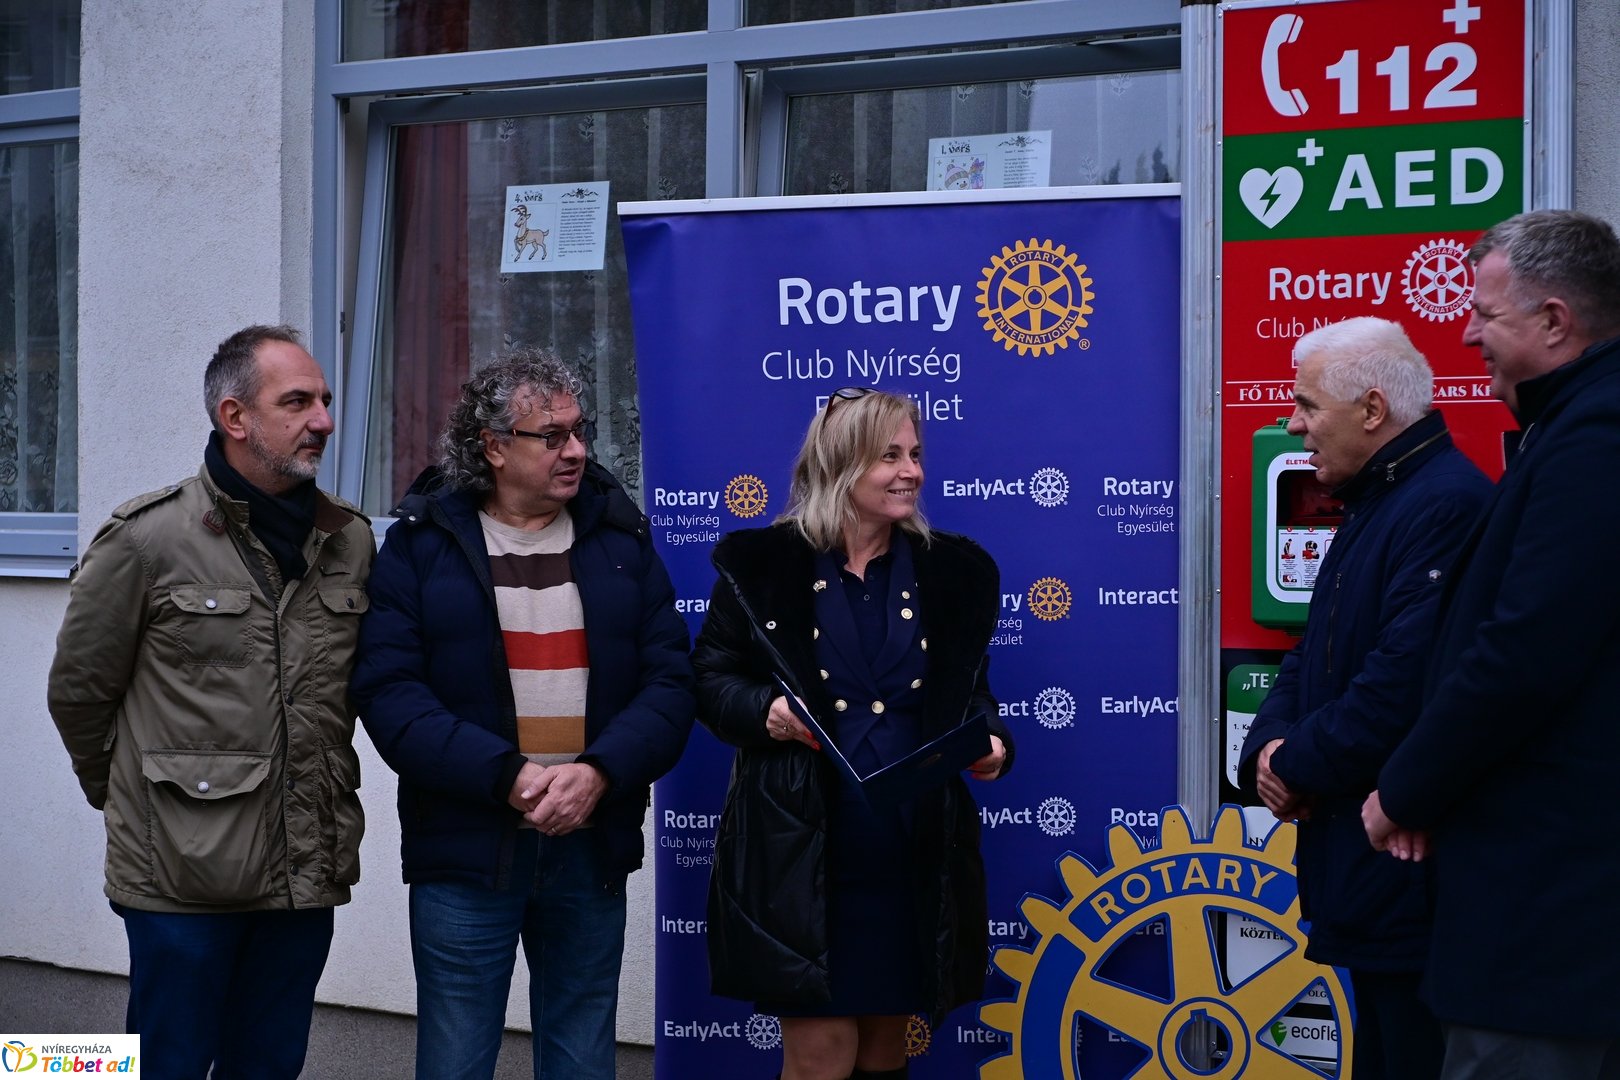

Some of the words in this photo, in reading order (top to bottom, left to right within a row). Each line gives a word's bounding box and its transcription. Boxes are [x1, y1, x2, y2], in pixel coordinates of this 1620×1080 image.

[1326, 42, 1477, 114] 112
[1328, 147, 1504, 211] AED
[1009, 251, 1059, 266] ROTARY
[1424, 247, 1459, 259] ROTARY
[1269, 267, 1392, 305] Rotary
[779, 277, 961, 332] Rotary
[1413, 292, 1472, 314] INTERNATIONAL
[995, 314, 1078, 344] INTERNATIONAL
[1256, 316, 1305, 338] Club
[762, 349, 834, 380] Club
[847, 347, 961, 385] Nyírség
[1239, 384, 1262, 400] FŐ
[943, 478, 1025, 500] EarlyAct
[1103, 477, 1174, 498] Rotary
[655, 488, 719, 509] Rotary
[1097, 504, 1126, 516] Club
[1129, 503, 1174, 518] Nyírség
[651, 514, 673, 526] Club
[677, 514, 720, 528] Nyírség
[1117, 520, 1174, 535] Egyesület
[666, 531, 720, 545] Egyesület
[1099, 587, 1179, 605] Interact
[997, 616, 1022, 631] rség
[988, 633, 1023, 645] esület
[979, 807, 1032, 828] lyAct
[1111, 807, 1158, 827] Rota
[660, 836, 683, 848] Club
[687, 836, 715, 851] Nyírs
[676, 854, 714, 868] Egyesü
[1090, 857, 1279, 926] ROTARY
[662, 915, 707, 933] Inter
[988, 919, 1028, 940] tary
[664, 1020, 740, 1041] EarlyAct
[1291, 1024, 1338, 1042] ecofle
